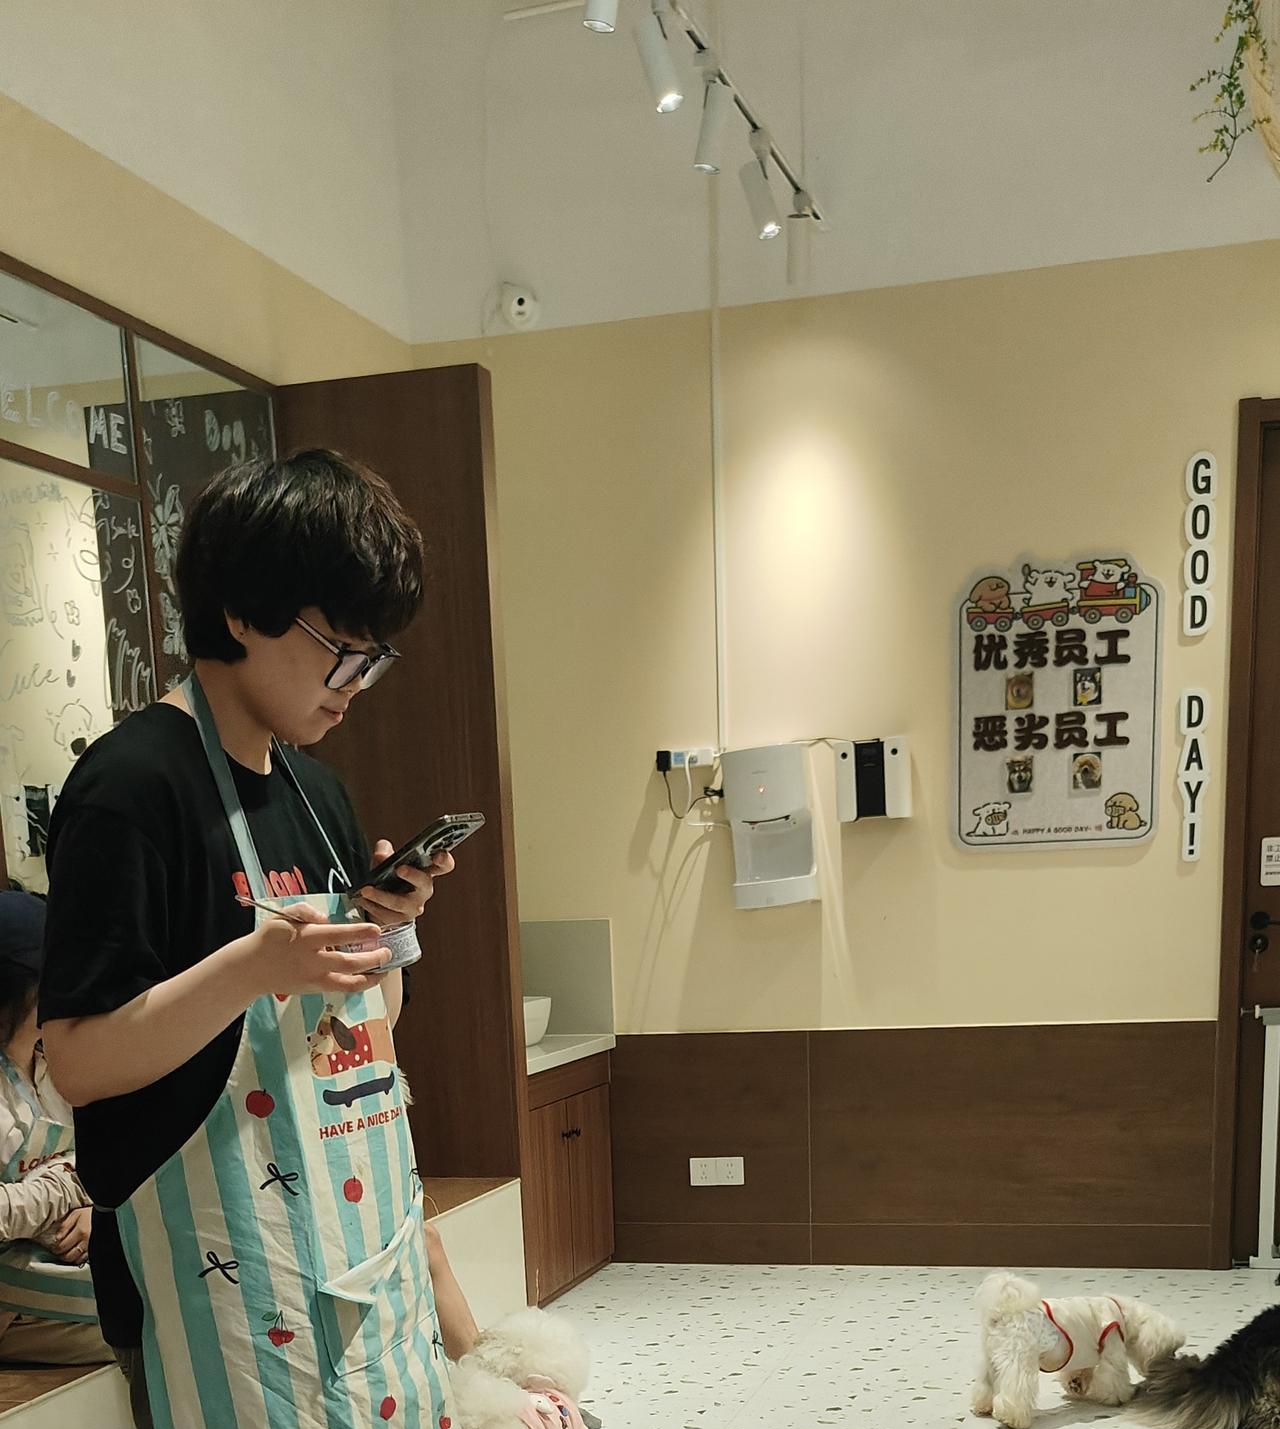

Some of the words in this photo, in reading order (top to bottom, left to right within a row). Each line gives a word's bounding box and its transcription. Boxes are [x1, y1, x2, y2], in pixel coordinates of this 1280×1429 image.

[1190, 458, 1211, 629] GOOD
[973, 628, 1131, 671] 优秀员工
[973, 711, 1130, 751] 恶劣员工
[1184, 695, 1204, 856] DAY!
[319, 1121, 354, 1140] HAVE
[356, 1117, 365, 1130] A
[367, 1111, 391, 1128] NICE
